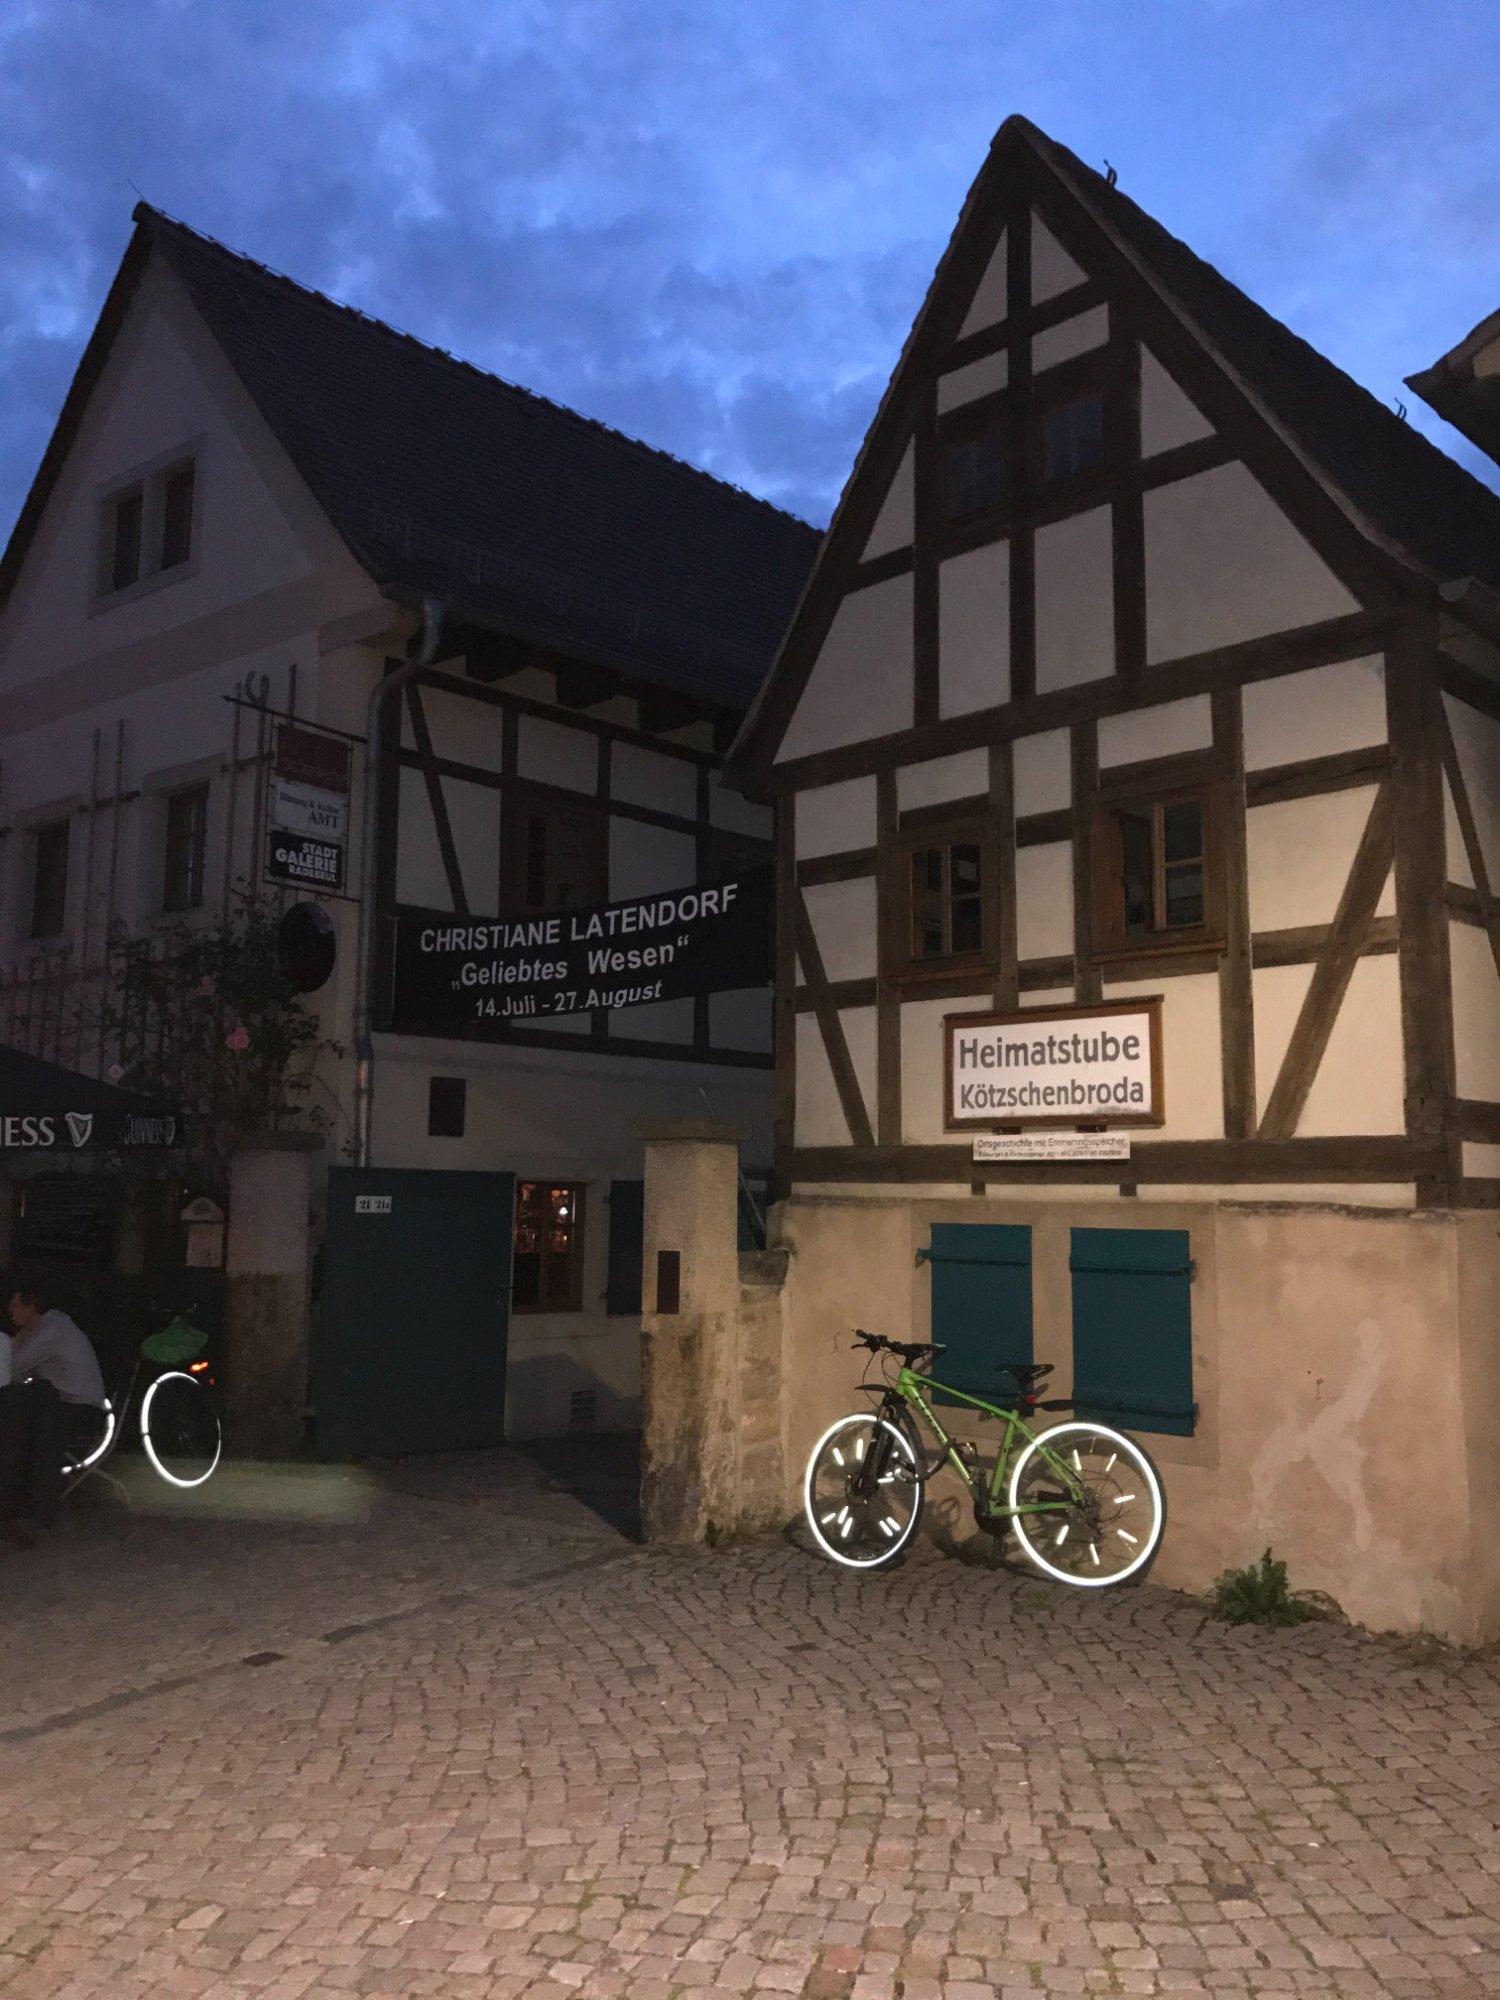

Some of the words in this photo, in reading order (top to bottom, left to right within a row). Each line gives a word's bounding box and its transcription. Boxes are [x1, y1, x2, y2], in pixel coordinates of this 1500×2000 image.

[307, 811, 339, 829] AMT
[275, 848, 337, 874] GALERIE
[302, 842, 338, 860] STADT
[289, 864, 337, 882] RADEBEUL
[420, 919, 561, 953] CHRISTIANE
[570, 883, 739, 942] LATENDORF
[451, 960, 569, 991] „Geliebtes
[475, 995, 536, 1017] 14.Juli
[959, 1031, 1140, 1069] Heimatstube
[960, 1076, 1144, 1109] Kötzschenbroda
